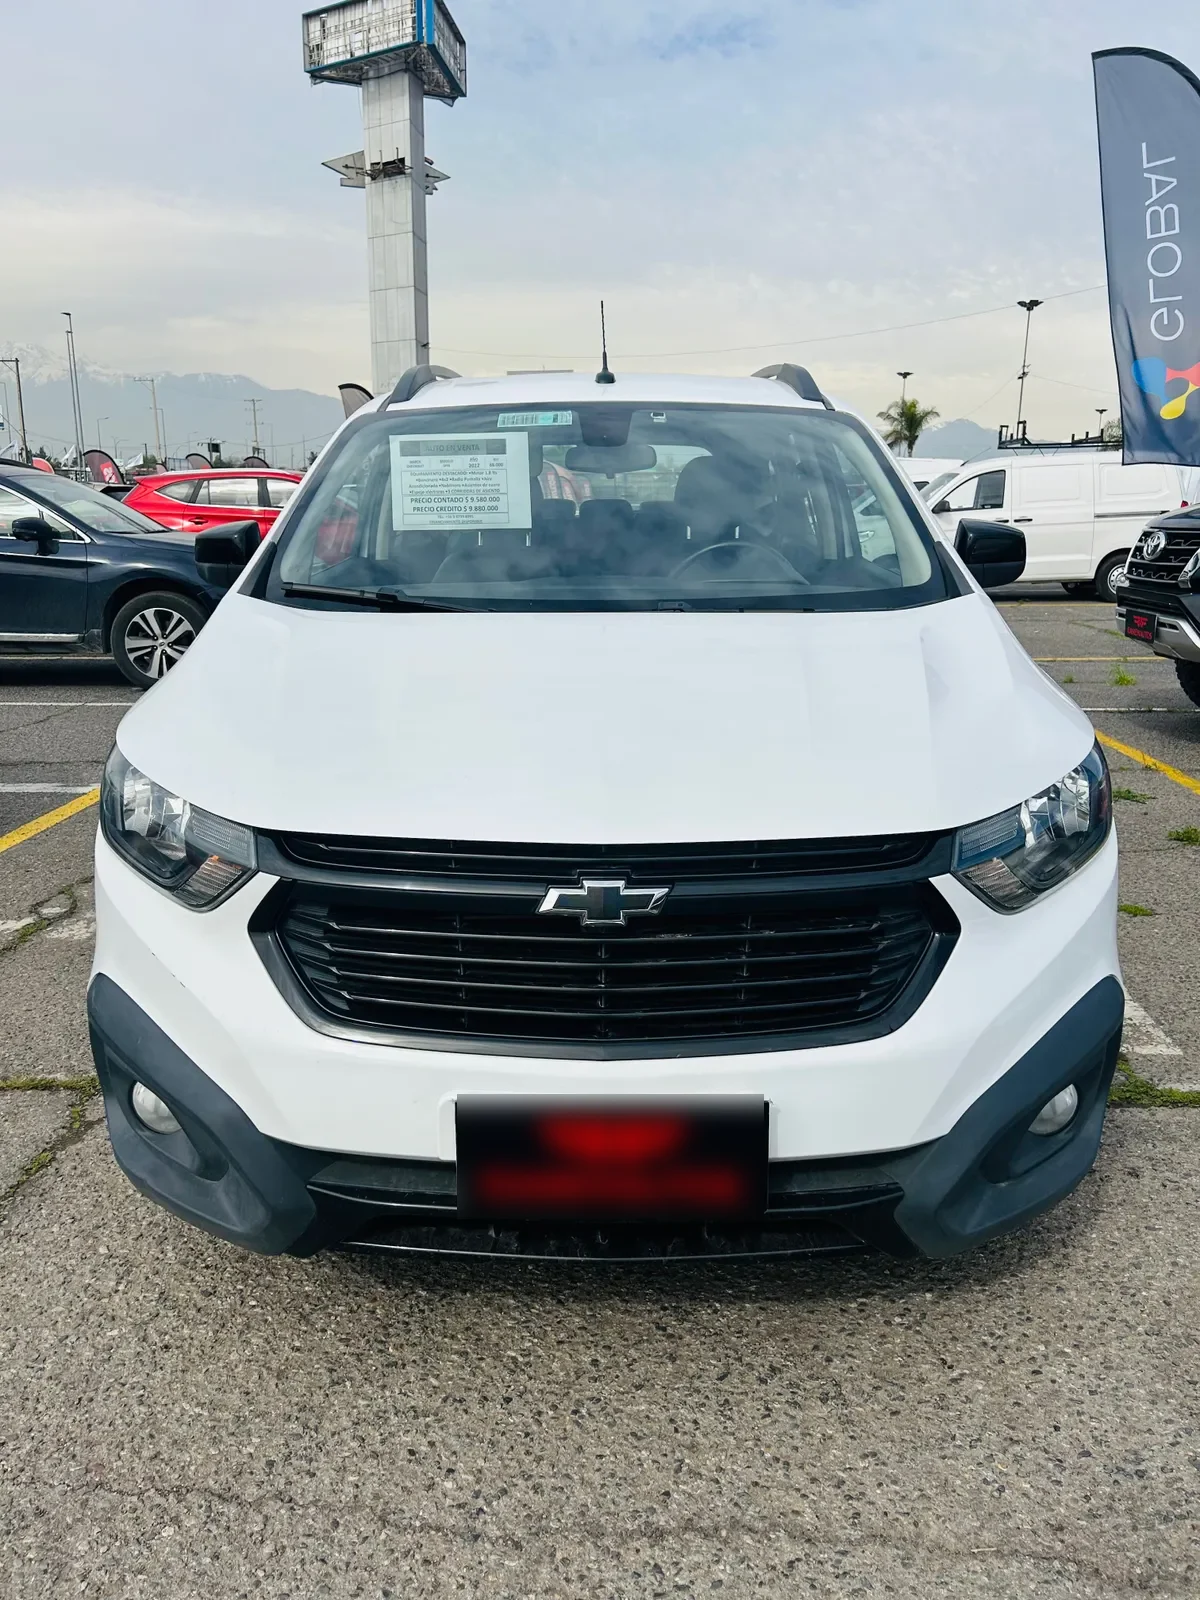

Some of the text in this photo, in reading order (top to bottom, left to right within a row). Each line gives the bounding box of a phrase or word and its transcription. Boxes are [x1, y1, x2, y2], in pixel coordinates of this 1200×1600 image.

[1141, 141, 1184, 341] GLOBAL
[424, 443, 480, 452] AUTO EN VENTA
[470, 495, 500, 503] 9.580.000
[463, 504, 468, 512] $
